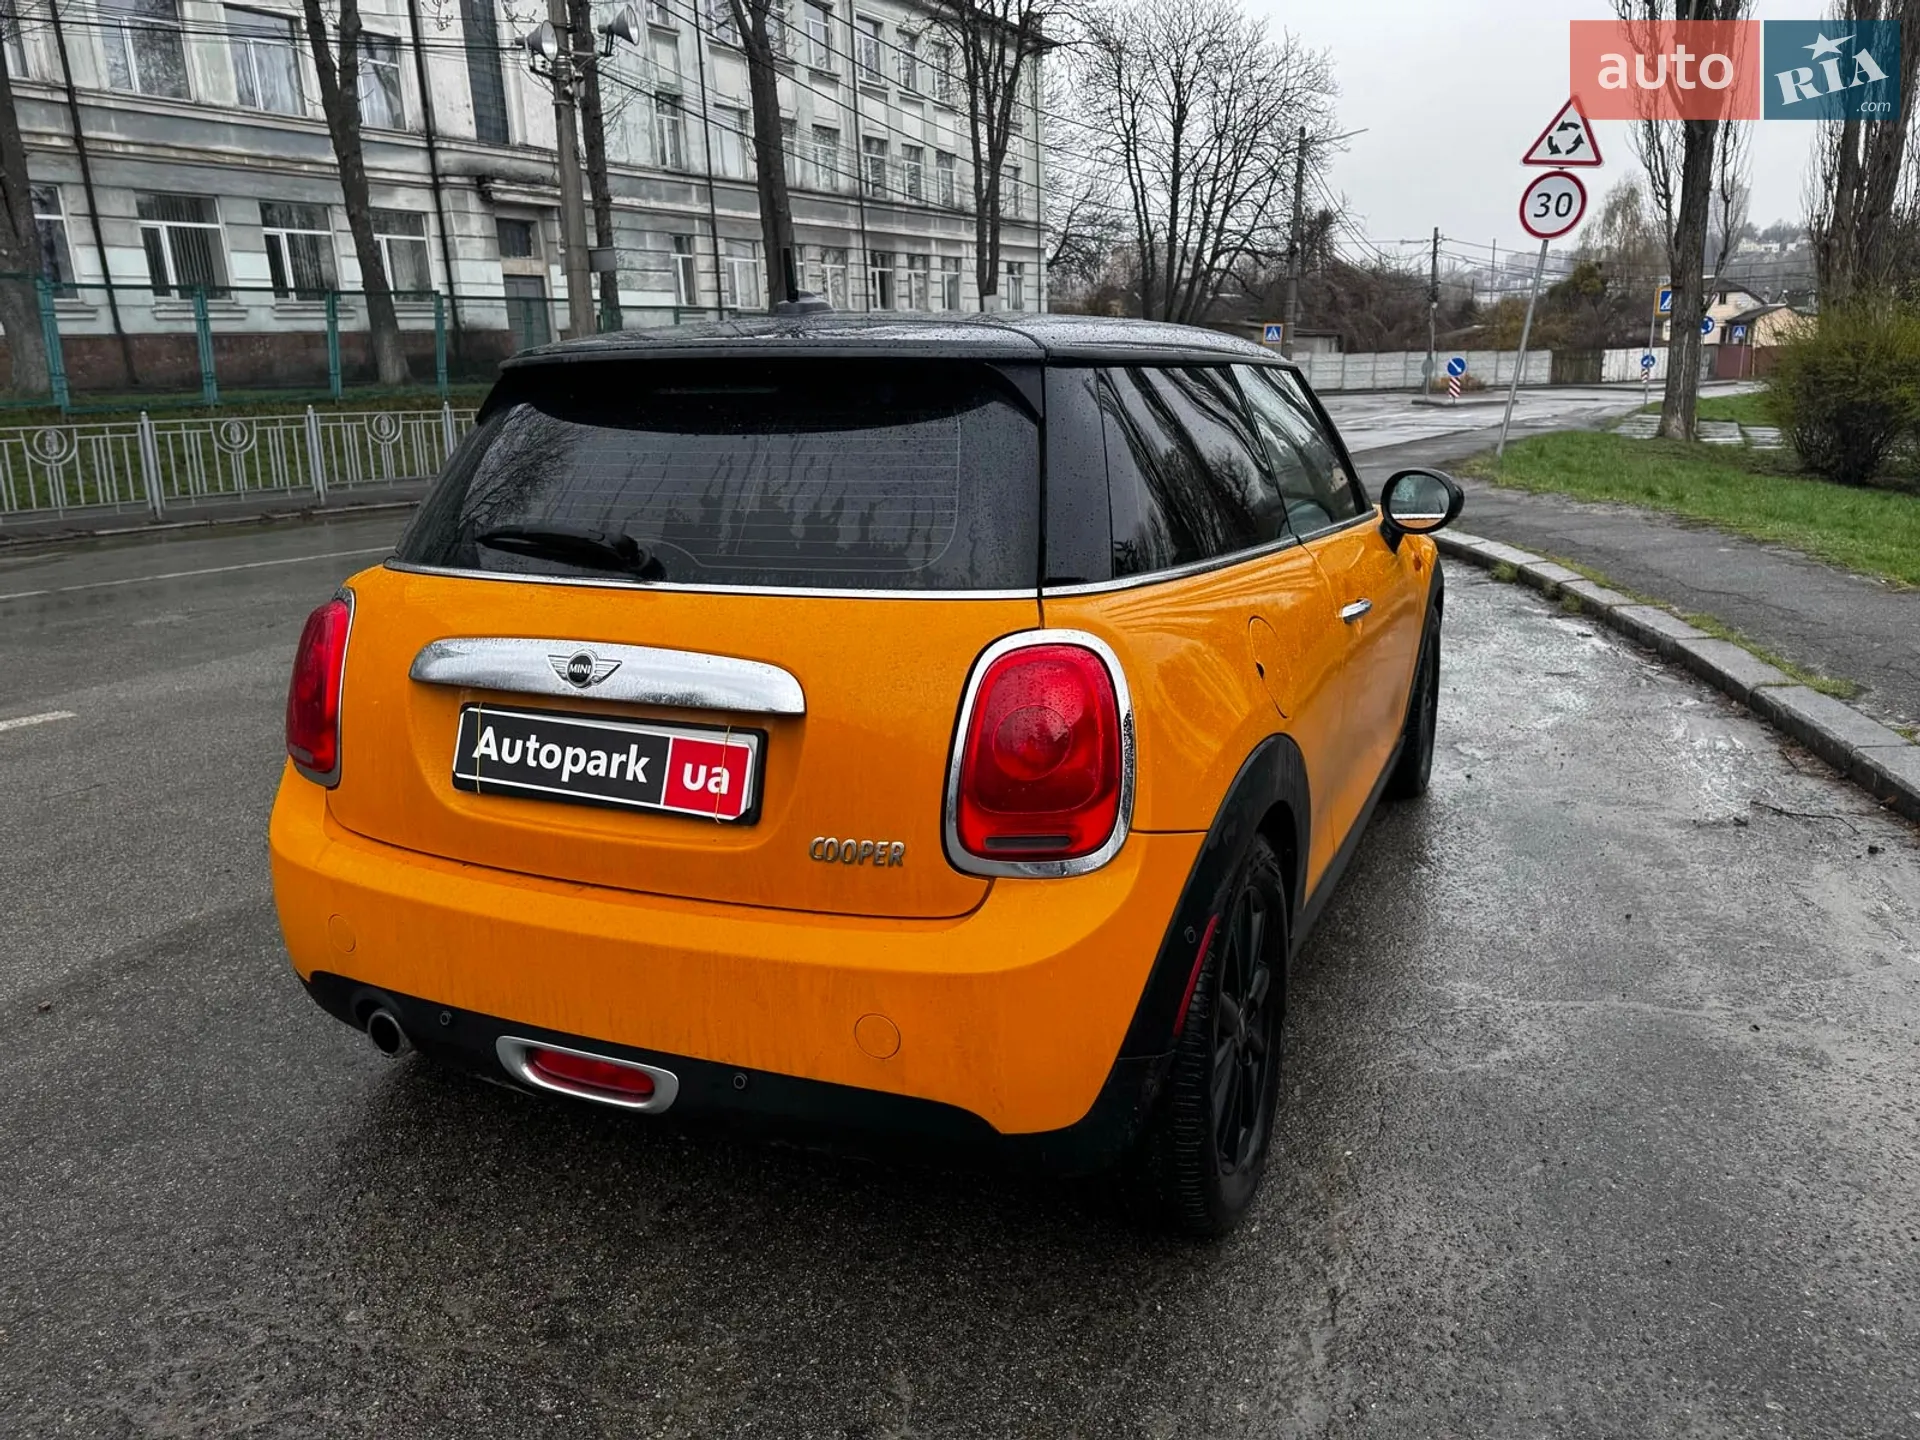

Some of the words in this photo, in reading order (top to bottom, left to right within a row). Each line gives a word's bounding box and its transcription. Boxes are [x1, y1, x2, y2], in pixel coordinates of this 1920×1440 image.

[1533, 192, 1573, 218] 30
[569, 663, 592, 675] MINI
[471, 725, 651, 784] Autopark
[682, 761, 730, 795] ua
[809, 836, 905, 867] COOPER
